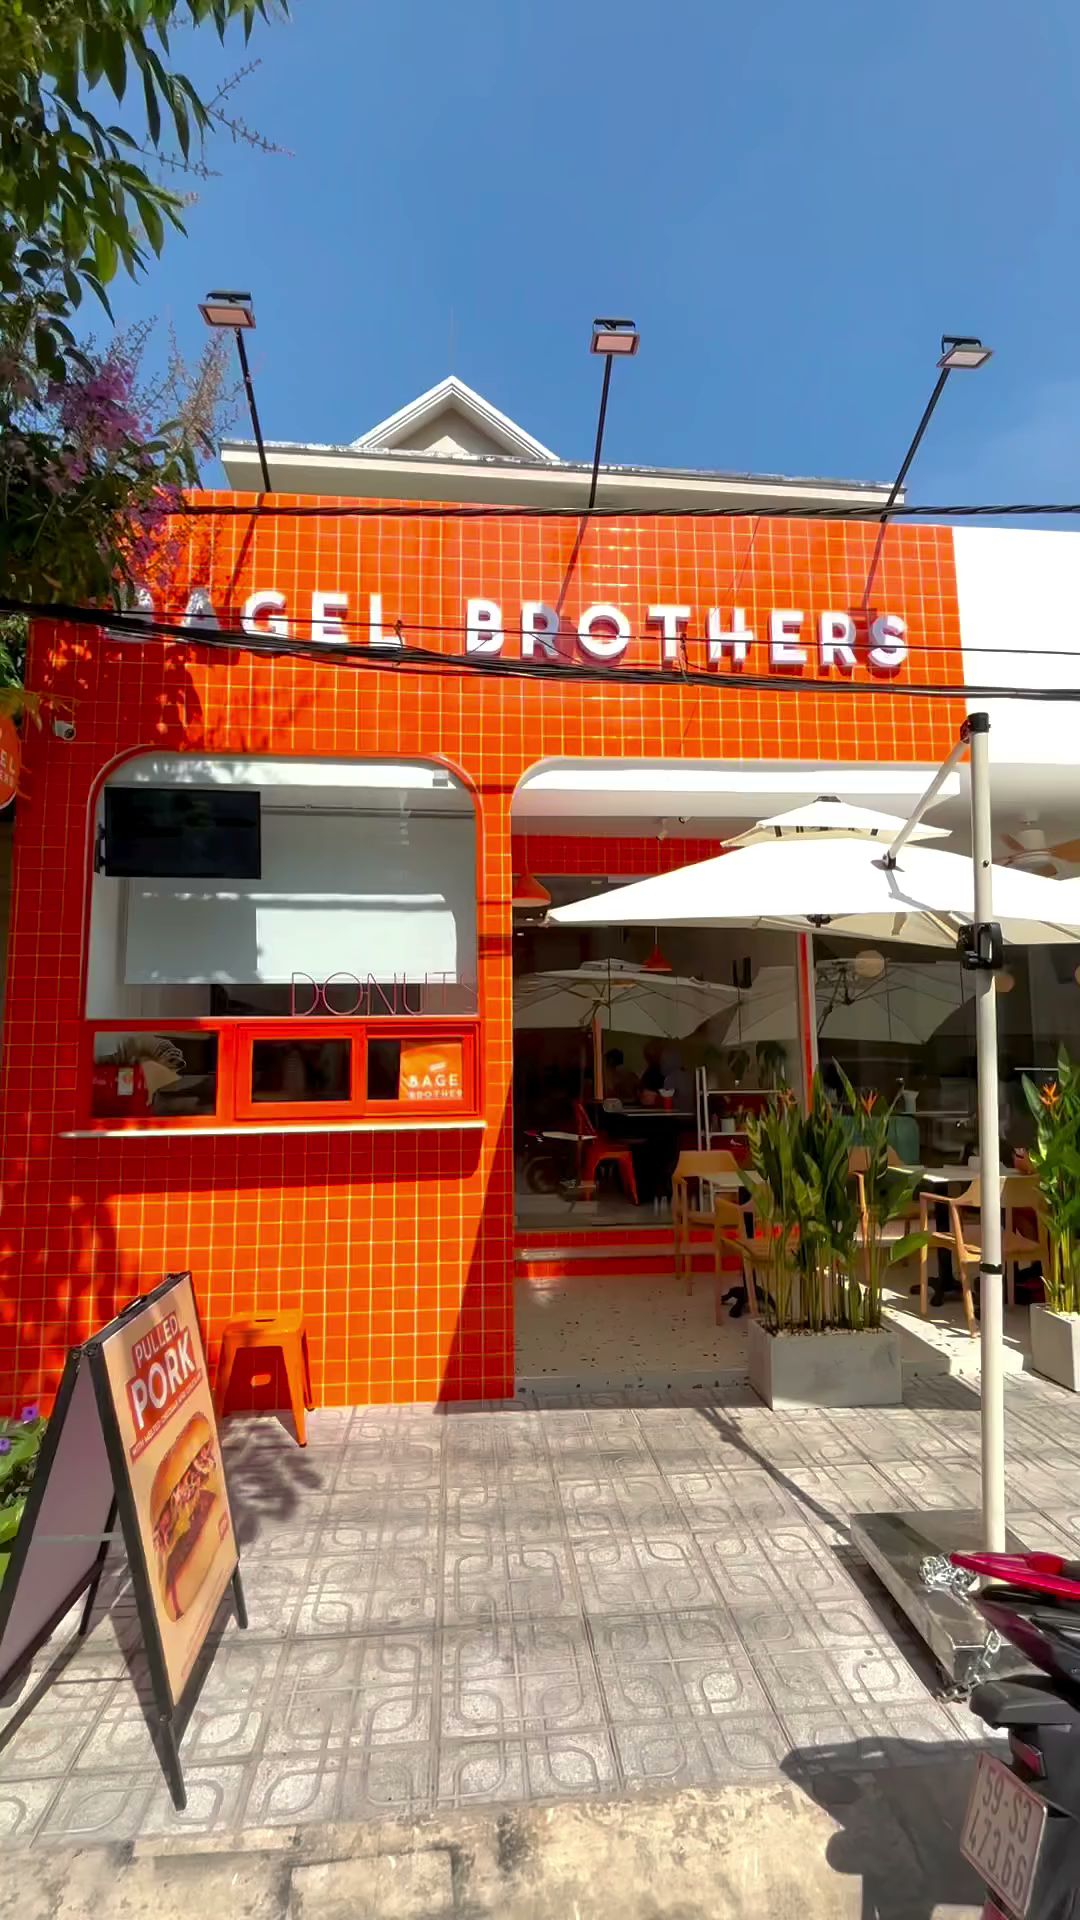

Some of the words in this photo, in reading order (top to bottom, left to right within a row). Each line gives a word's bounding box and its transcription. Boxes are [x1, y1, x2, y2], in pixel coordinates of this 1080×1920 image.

[466, 599, 908, 667] BROTHERS
[135, 1316, 178, 1368] PULLED
[131, 1331, 195, 1430] PORK
